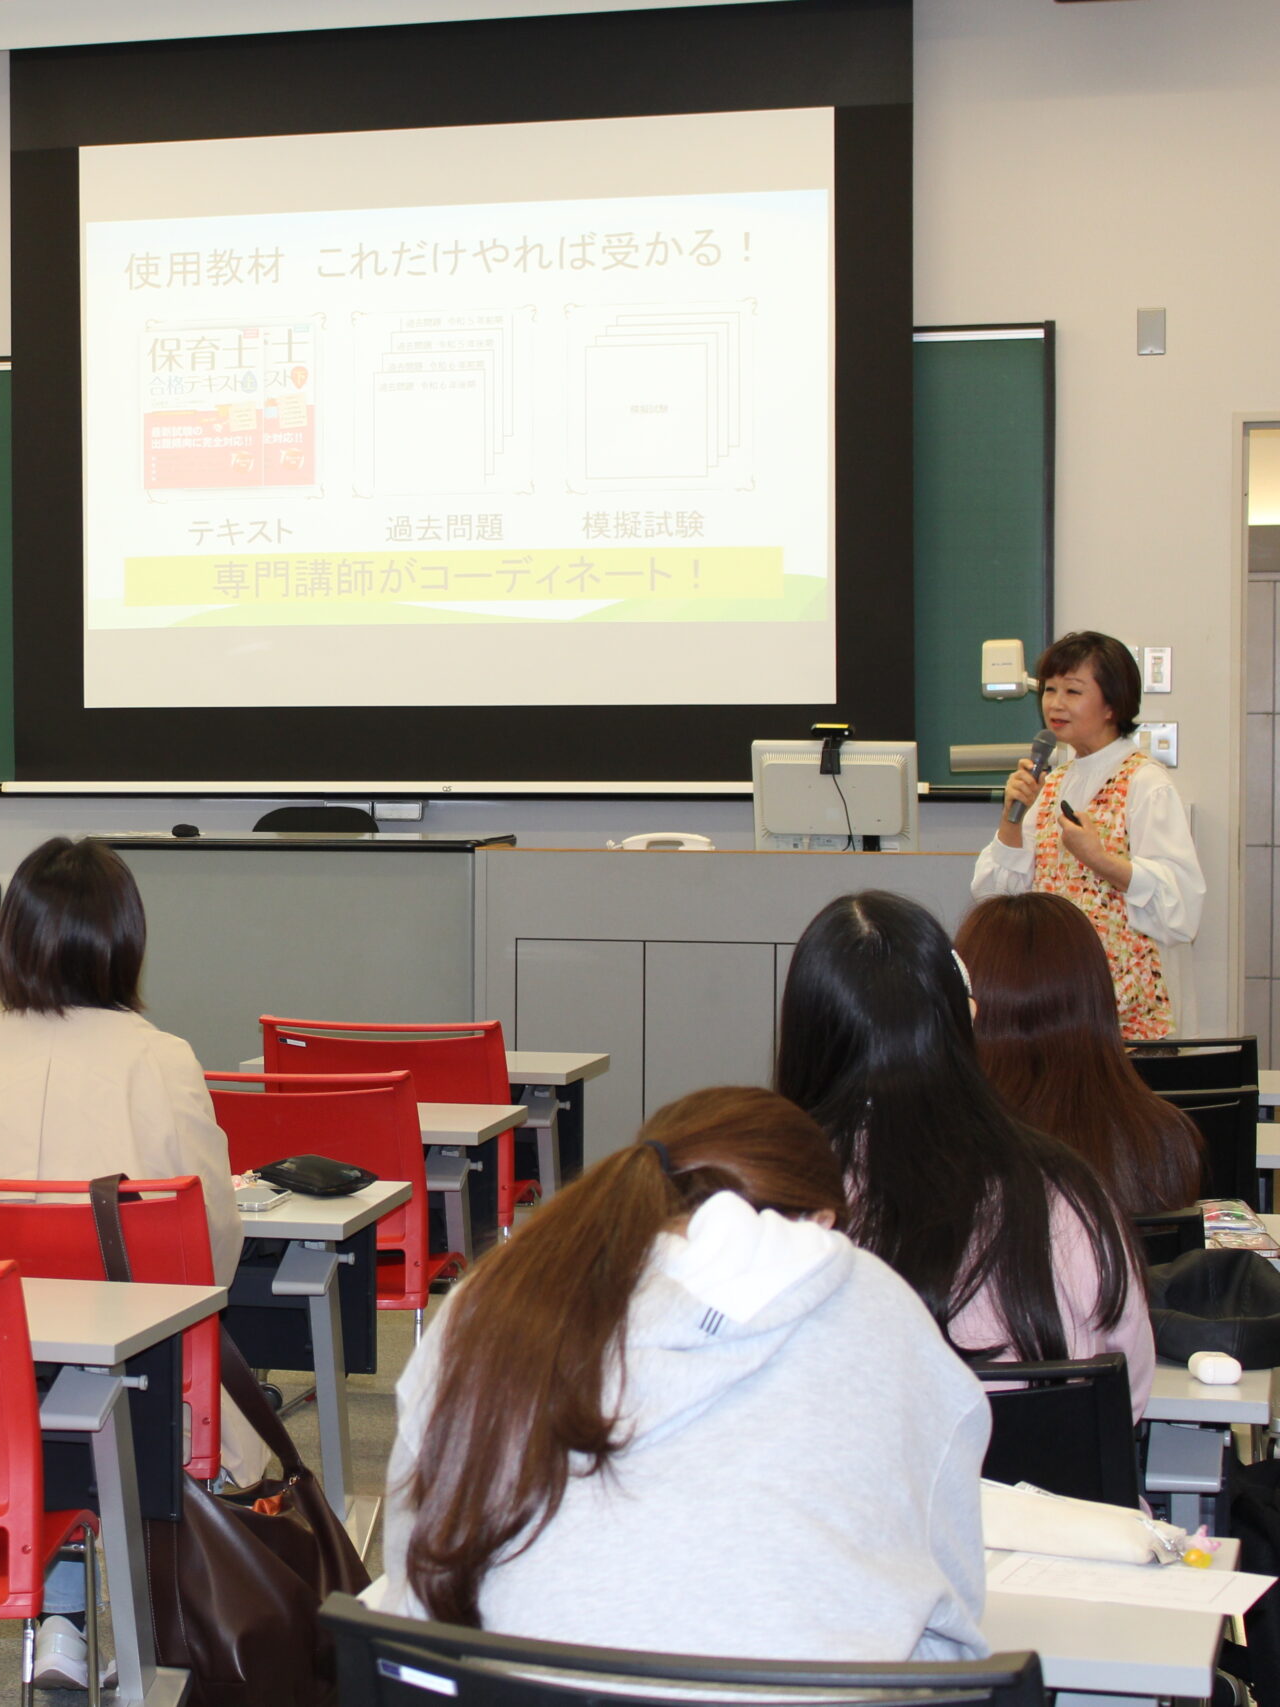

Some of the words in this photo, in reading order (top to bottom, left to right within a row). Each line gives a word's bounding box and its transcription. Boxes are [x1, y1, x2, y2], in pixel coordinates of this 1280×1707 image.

[122, 245, 286, 290] 使用教材
[316, 228, 754, 279] これだけやれば受かる！
[147, 334, 259, 373] 保育士
[264, 328, 310, 365] 士
[187, 517, 295, 547] テキスト
[384, 513, 505, 543] 過去問題
[581, 509, 706, 540] 模擬試験
[212, 554, 702, 600] 専門講師がコーディネート！
